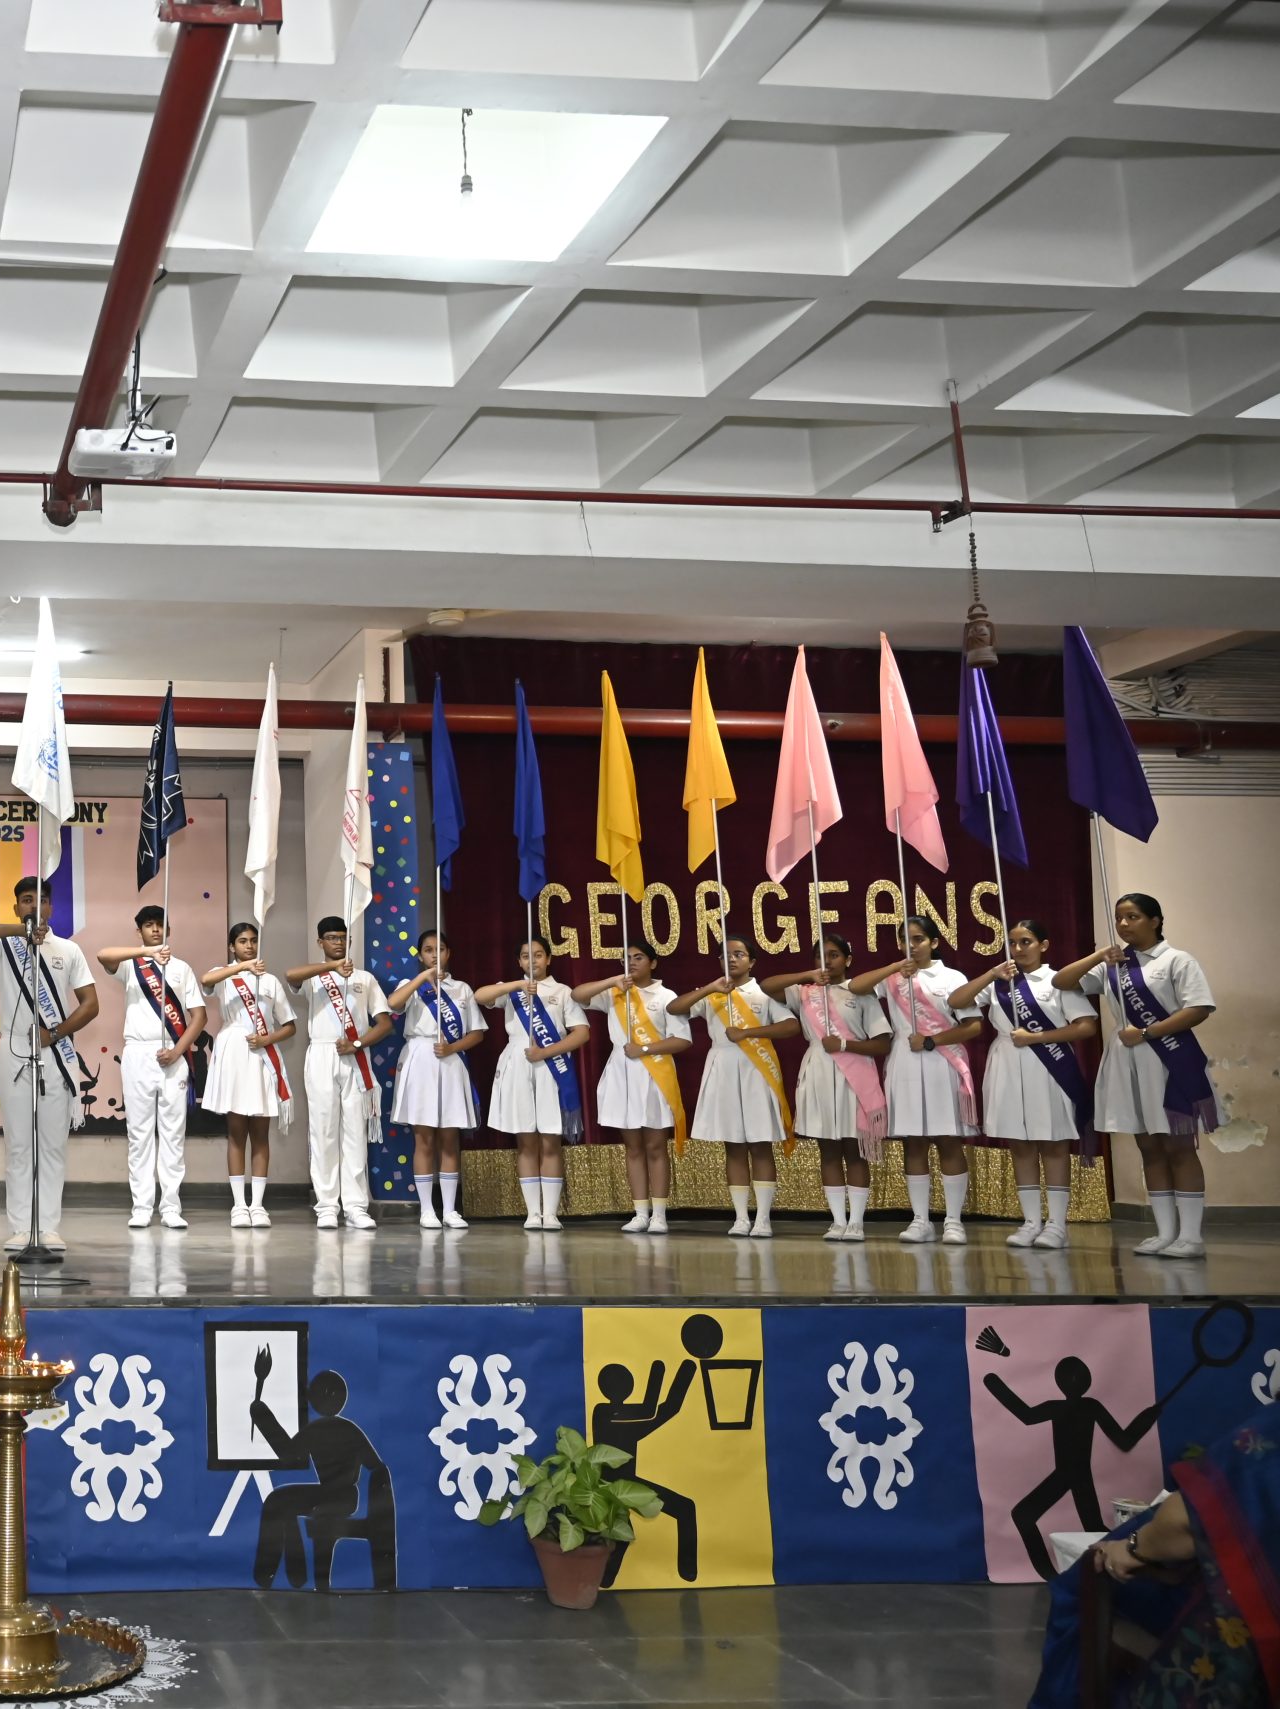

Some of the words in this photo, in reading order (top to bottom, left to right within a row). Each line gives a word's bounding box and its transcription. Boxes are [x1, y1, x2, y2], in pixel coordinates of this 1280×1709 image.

[538, 879, 1006, 960] GEORGEANS
[11, 935, 31, 971] SIDENT
[27, 975, 57, 1018] DENT
[50, 1021, 75, 1063] NCIL
[320, 973, 354, 1030] DISCIPNE
[1120, 963, 1133, 990] USE
[163, 1003, 182, 1025] BOY
[237, 984, 268, 1037] DISCINE
[1007, 988, 1033, 1021] USE
[1026, 1019, 1065, 1062] CAAIN
[1125, 987, 1180, 1052] VICE-CAIN
[531, 1013, 568, 1074] VICE-CTAIN
[634, 1026, 663, 1063] CAPN
